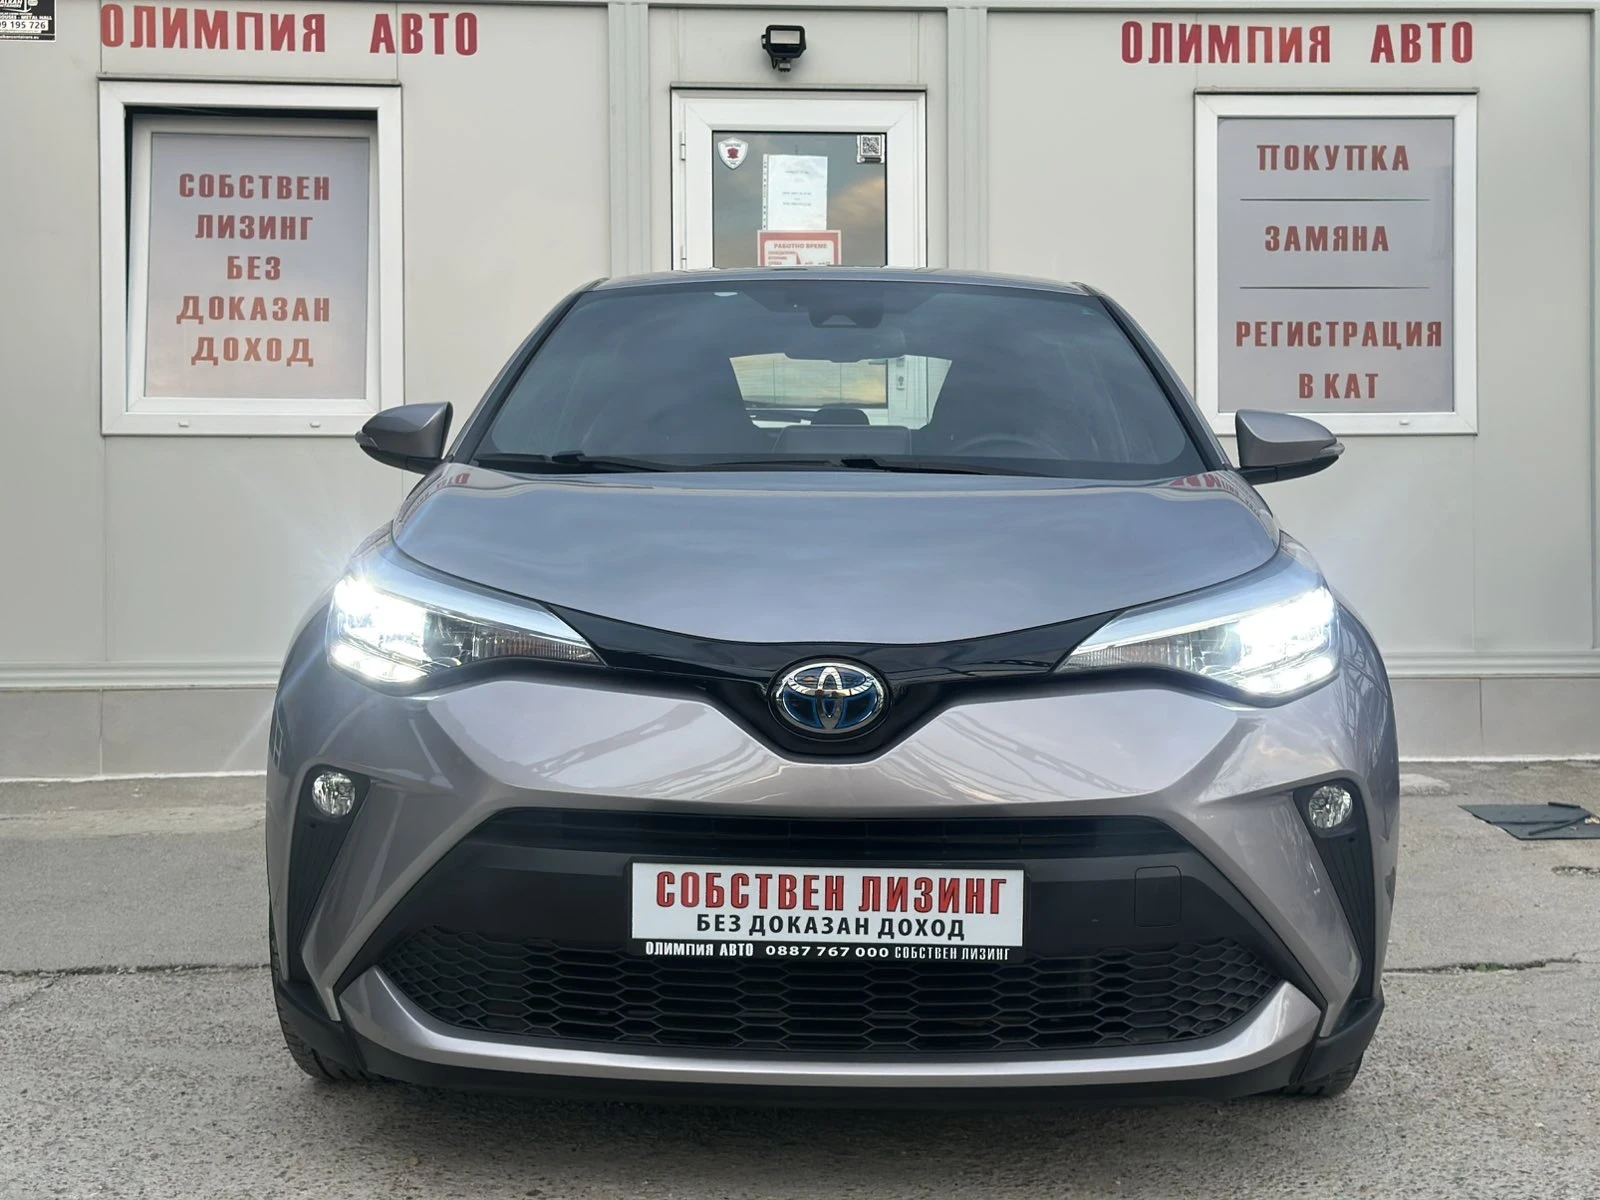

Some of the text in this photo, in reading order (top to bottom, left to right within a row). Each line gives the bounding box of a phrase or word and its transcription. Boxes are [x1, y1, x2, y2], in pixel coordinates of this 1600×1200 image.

[10, 21, 26, 29] 195
[101, 4, 478, 56] ОЛИМПИЯ АВТО
[1121, 21, 1473, 64] ОЛИМПИЯ АВТО
[1257, 144, 1409, 171] ПОКУПКА
[179, 174, 329, 201] СОБСТВЕН
[195, 215, 313, 241] ЛИЗИНГ
[1265, 226, 1389, 252] ЗАМЯНА
[227, 256, 281, 281] БЕЗ
[176, 296, 330, 325] ДОКАЗАН
[1236, 321, 1442, 350] РЕГИСТРАЦИЯ
[191, 336, 314, 367] ДОХОД
[1299, 374, 1378, 399] В КАТ
[656, 871, 1007, 914] СОБСТВЕН ЛИЗИНГ
[697, 914, 965, 940] БЕЗ ДОКАЗАН ДОХОД
[645, 941, 1010, 960] ОЛИМПИЯ АВТО 0887 767 000 СОБСТВЕН ЛИЗИНГ
